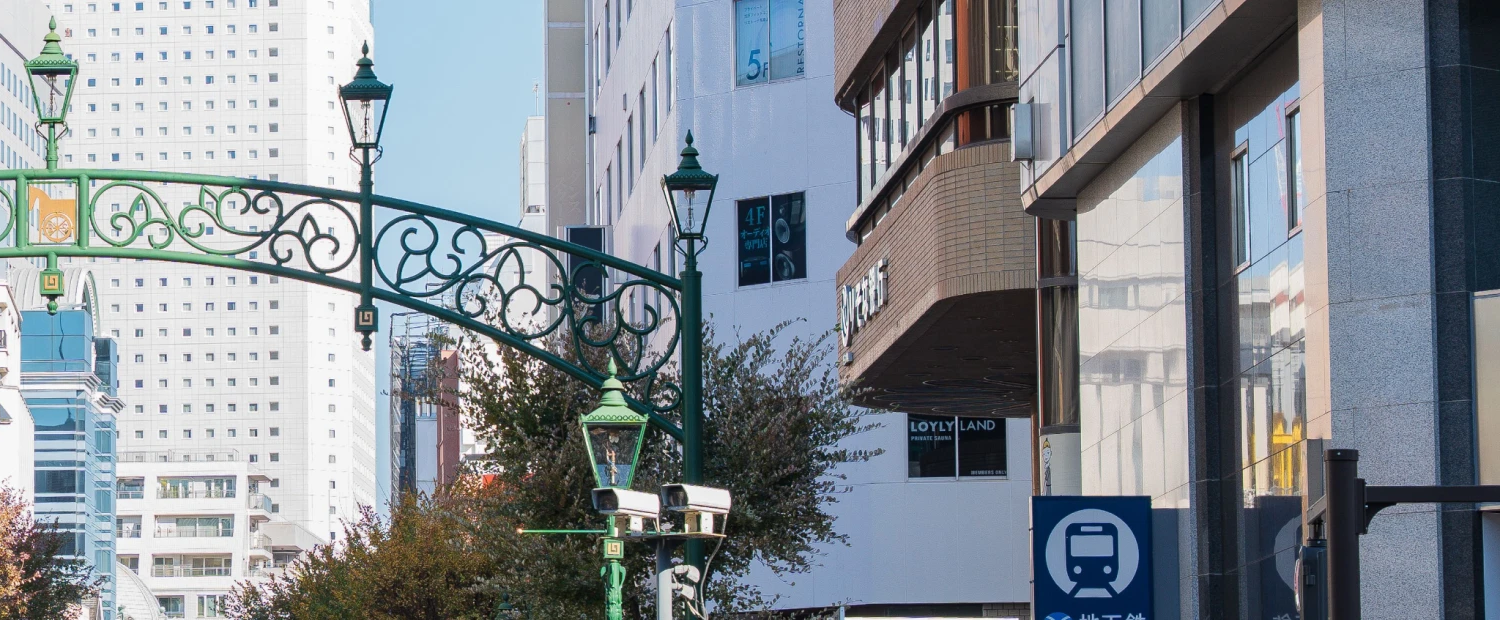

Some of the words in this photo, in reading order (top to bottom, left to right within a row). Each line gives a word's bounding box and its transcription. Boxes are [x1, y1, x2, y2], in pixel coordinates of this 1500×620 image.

[746, 48, 768, 80] 5F
[745, 205, 766, 226] 4F
[910, 421, 955, 432] LOYLY
[960, 420, 996, 431] LAND
